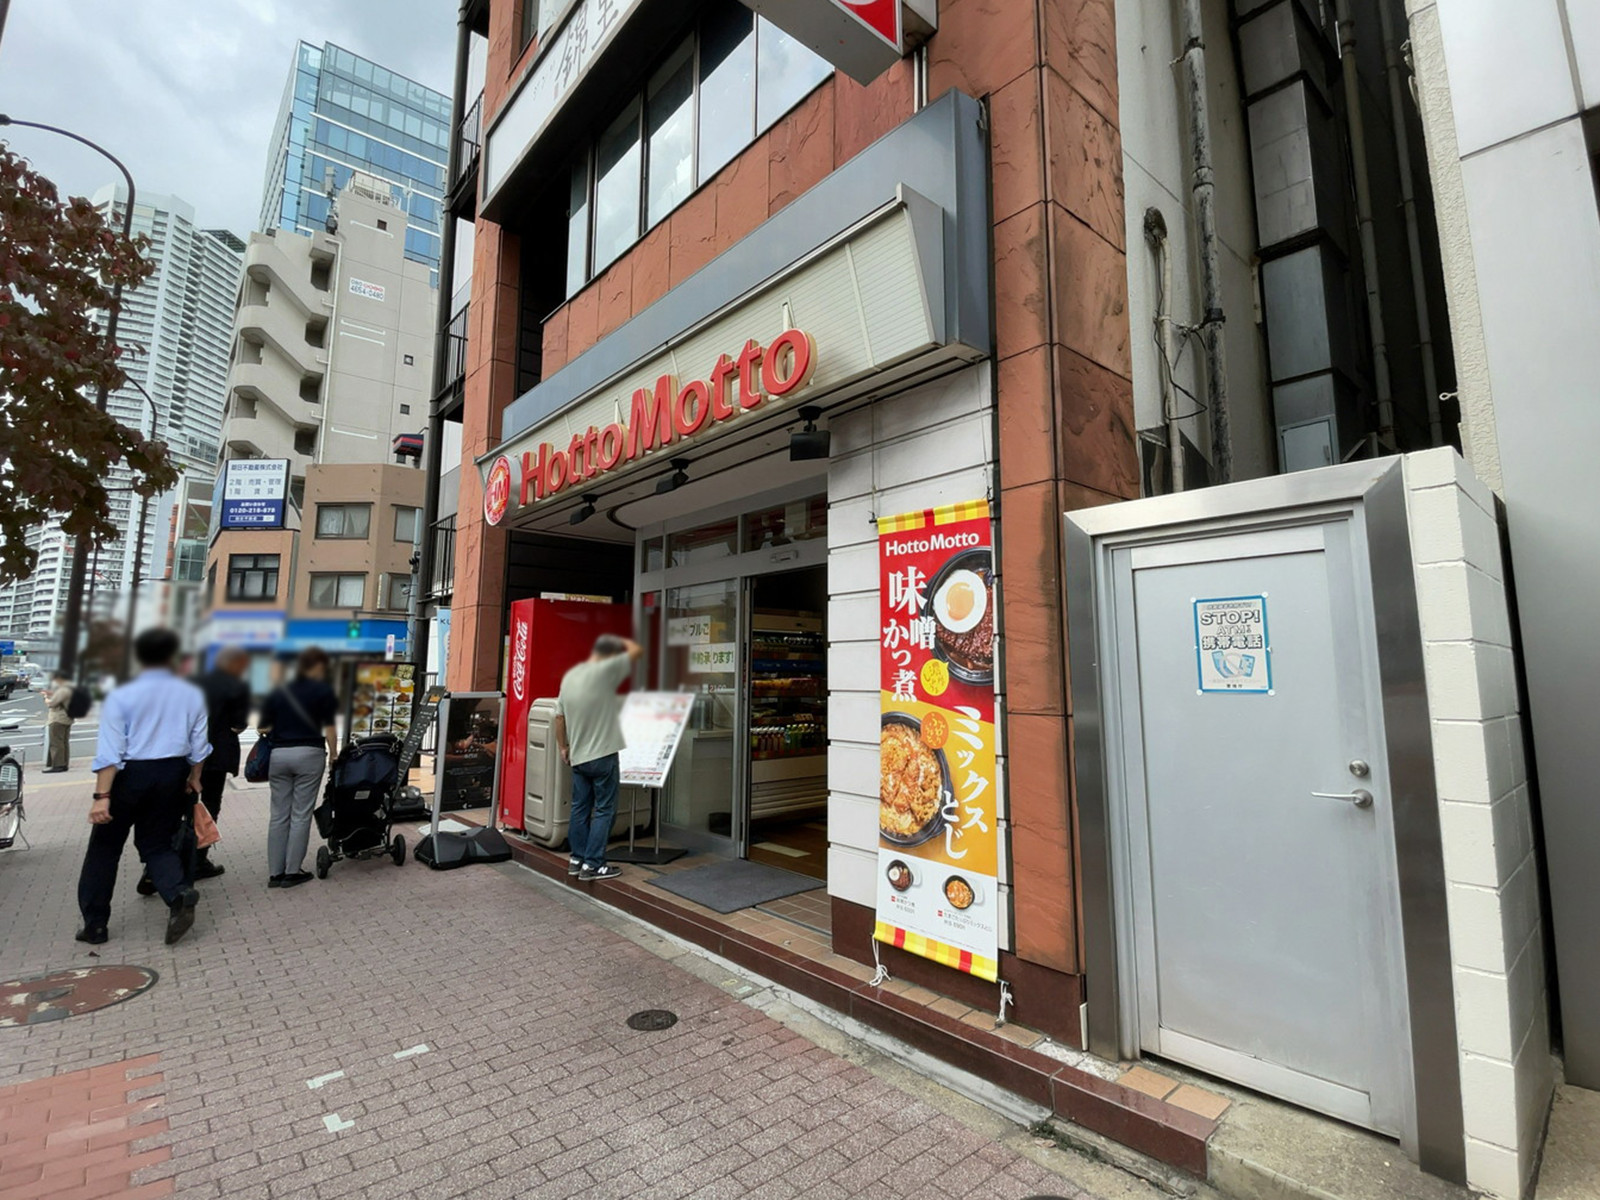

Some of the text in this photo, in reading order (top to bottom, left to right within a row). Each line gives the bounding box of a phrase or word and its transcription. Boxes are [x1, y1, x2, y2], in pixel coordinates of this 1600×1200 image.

[519, 328, 816, 507] HottoMotto
[885, 532, 980, 557] HottoMotto
[1200, 610, 1261, 626] STOP!
[1202, 634, 1263, 650] 携帯電話
[951, 705, 990, 834] ミックス
[941, 790, 968, 860] とじ
